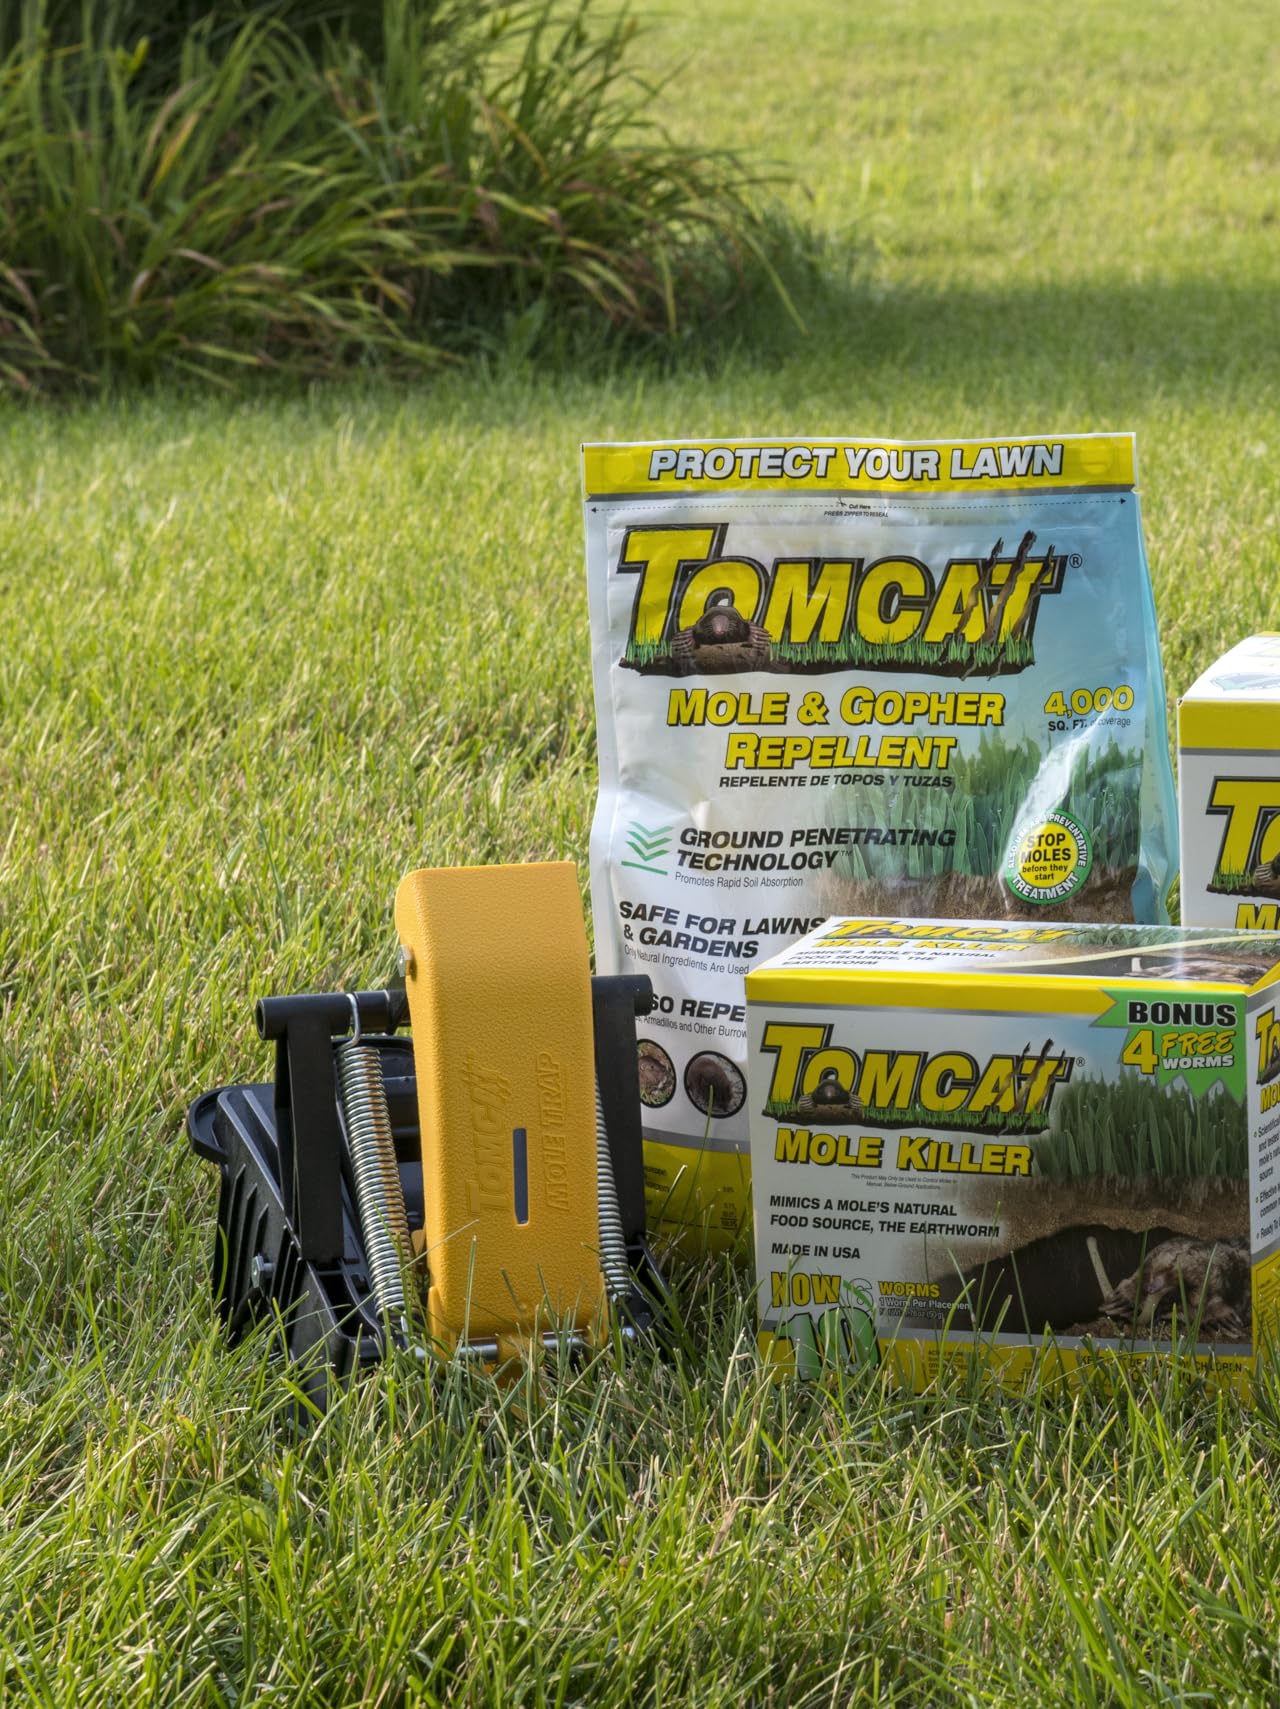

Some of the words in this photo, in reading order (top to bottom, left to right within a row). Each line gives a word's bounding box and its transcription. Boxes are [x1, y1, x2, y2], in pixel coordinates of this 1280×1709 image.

[649, 447, 835, 480] PROTECT
[845, 446, 939, 480] YOUR
[950, 443, 1063, 478] LAWN
[617, 523, 1071, 650] TOMCAT
[667, 687, 791, 727] MOLE
[797, 690, 829, 725] &
[839, 686, 1006, 728] GOPHER
[1044, 684, 1135, 719] 4,000
[1048, 720, 1069, 732] SQ.
[725, 733, 958, 770] REPELLENT
[719, 776, 807, 789] REPELENTE
[810, 776, 830, 788] DE
[833, 775, 885, 788] TOPOS
[902, 775, 954, 789] TUZAS
[679, 826, 784, 849] GROUND
[789, 826, 957, 849] PENETRATING
[1026, 832, 1066, 849] STOP
[1020, 847, 1072, 864] MOLES
[674, 871, 715, 888] Promotes
[717, 875, 742, 889] Rapid
[743, 875, 759, 888] Soil
[760, 875, 804, 889] Absorption
[1022, 864, 1048, 873] before
[1049, 863, 1069, 873] they
[1034, 873, 1055, 881] start
[1012, 871, 1079, 900] TREATMENT
[618, 900, 681, 926] SAFE
[684, 913, 737, 936] FOR
[742, 916, 827, 936] LAWNS
[623, 923, 635, 941] &
[638, 927, 760, 959] GARDENS
[636, 948, 661, 964] Natural
[661, 951, 708, 972] Ingredients
[709, 961, 726, 974] Are
[727, 962, 750, 976] Used
[680, 999, 746, 1023] REPE
[1127, 1000, 1237, 1027] BONUS
[693, 1024, 717, 1036] Other
[1122, 1029, 1159, 1075] 4
[1161, 1029, 1237, 1058] FREE
[1163, 1054, 1235, 1070] WORMS
[759, 1021, 1075, 1117] TOMCAT
[774, 1127, 886, 1168] MOLE
[896, 1136, 1035, 1177] KILLER
[769, 1194, 821, 1211] MIMICS
[823, 1198, 834, 1211] A
[836, 1199, 890, 1214] MOLE'S
[893, 1202, 958, 1217] NATURAL
[770, 1214, 809, 1228] FOOD
[812, 1216, 874, 1234] SOURCE,
[878, 1220, 906, 1234] THE
[909, 1222, 1000, 1238] EARTHWORM
[771, 1242, 811, 1257] MADE
[814, 1245, 829, 1258] IN
[832, 1246, 861, 1260] USA
[770, 1271, 842, 1308] NOW
[877, 1281, 941, 1298] WORMS
